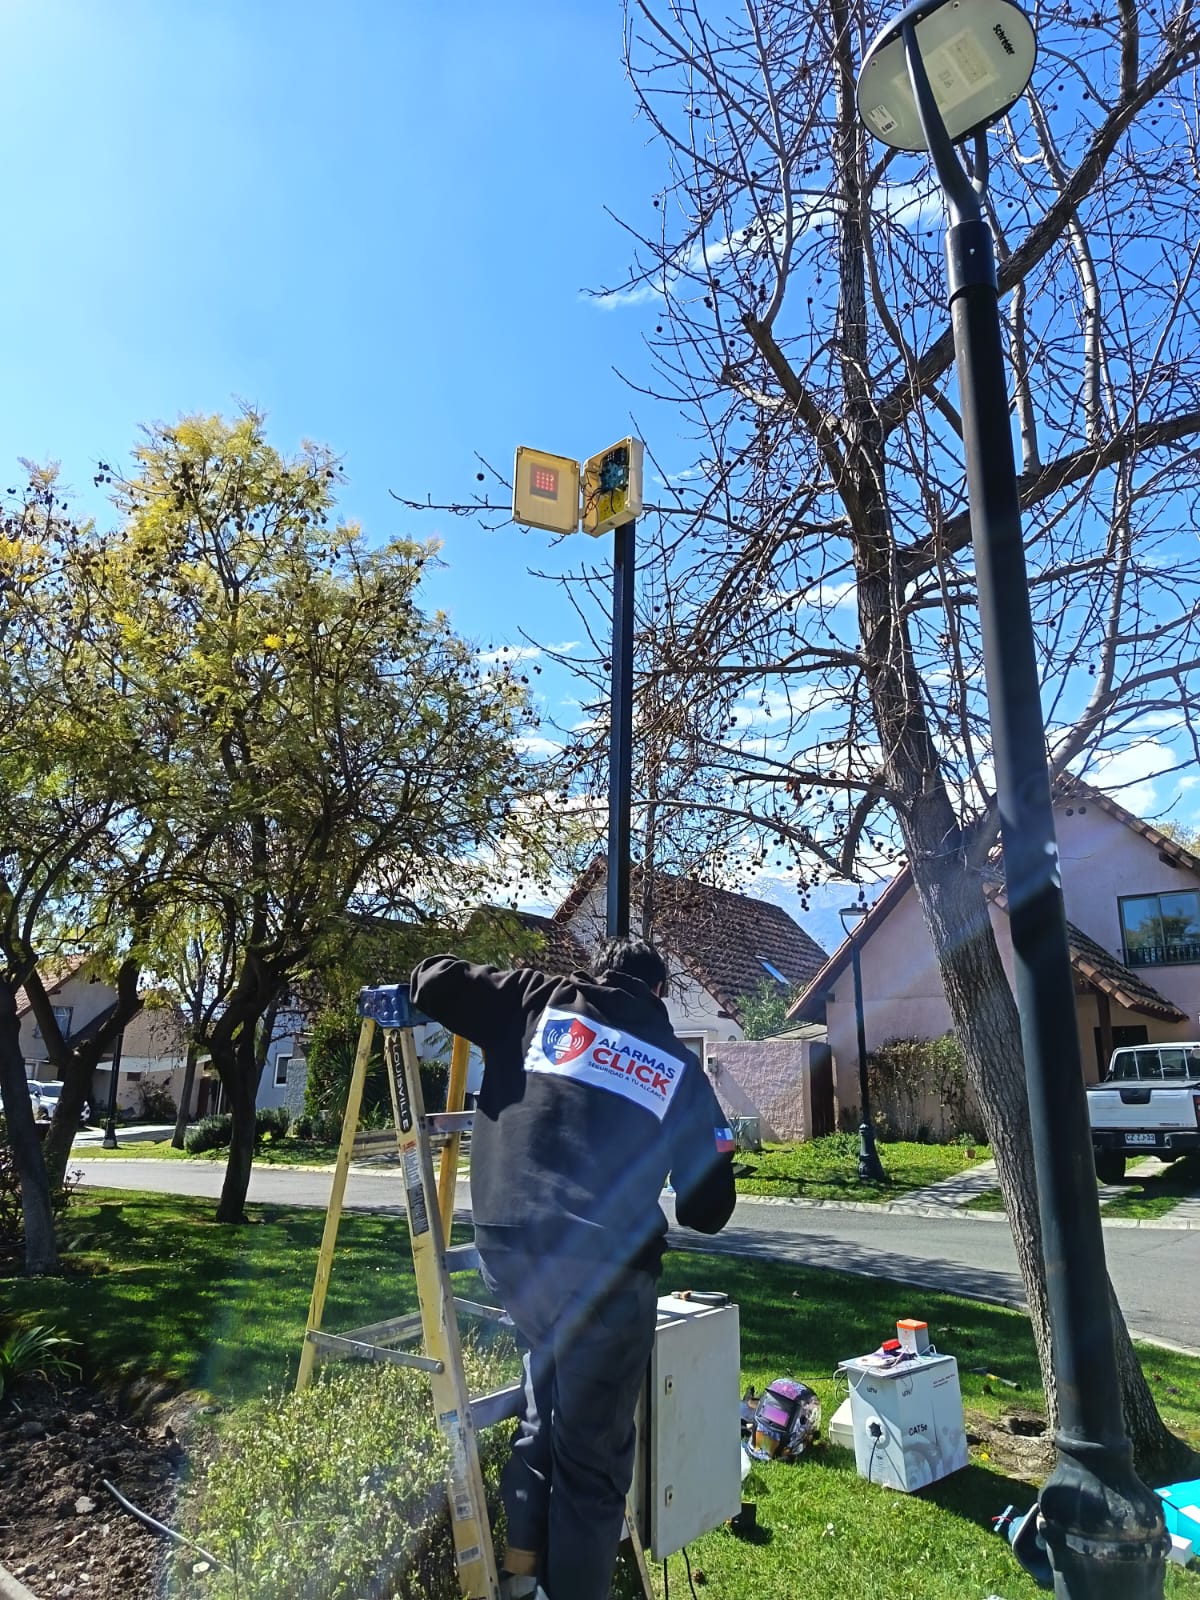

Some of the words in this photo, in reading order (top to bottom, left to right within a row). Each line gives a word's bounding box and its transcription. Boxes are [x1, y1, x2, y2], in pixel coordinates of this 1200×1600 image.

[588, 1061, 624, 1079] SEGURIDAD
[631, 1078, 640, 1086] TU
[592, 1047, 671, 1096] CLICK
[598, 1038, 676, 1079] ALARMAS
[392, 1043, 409, 1129] LOUISVILLE
[909, 1424, 928, 1436] CAT5e
